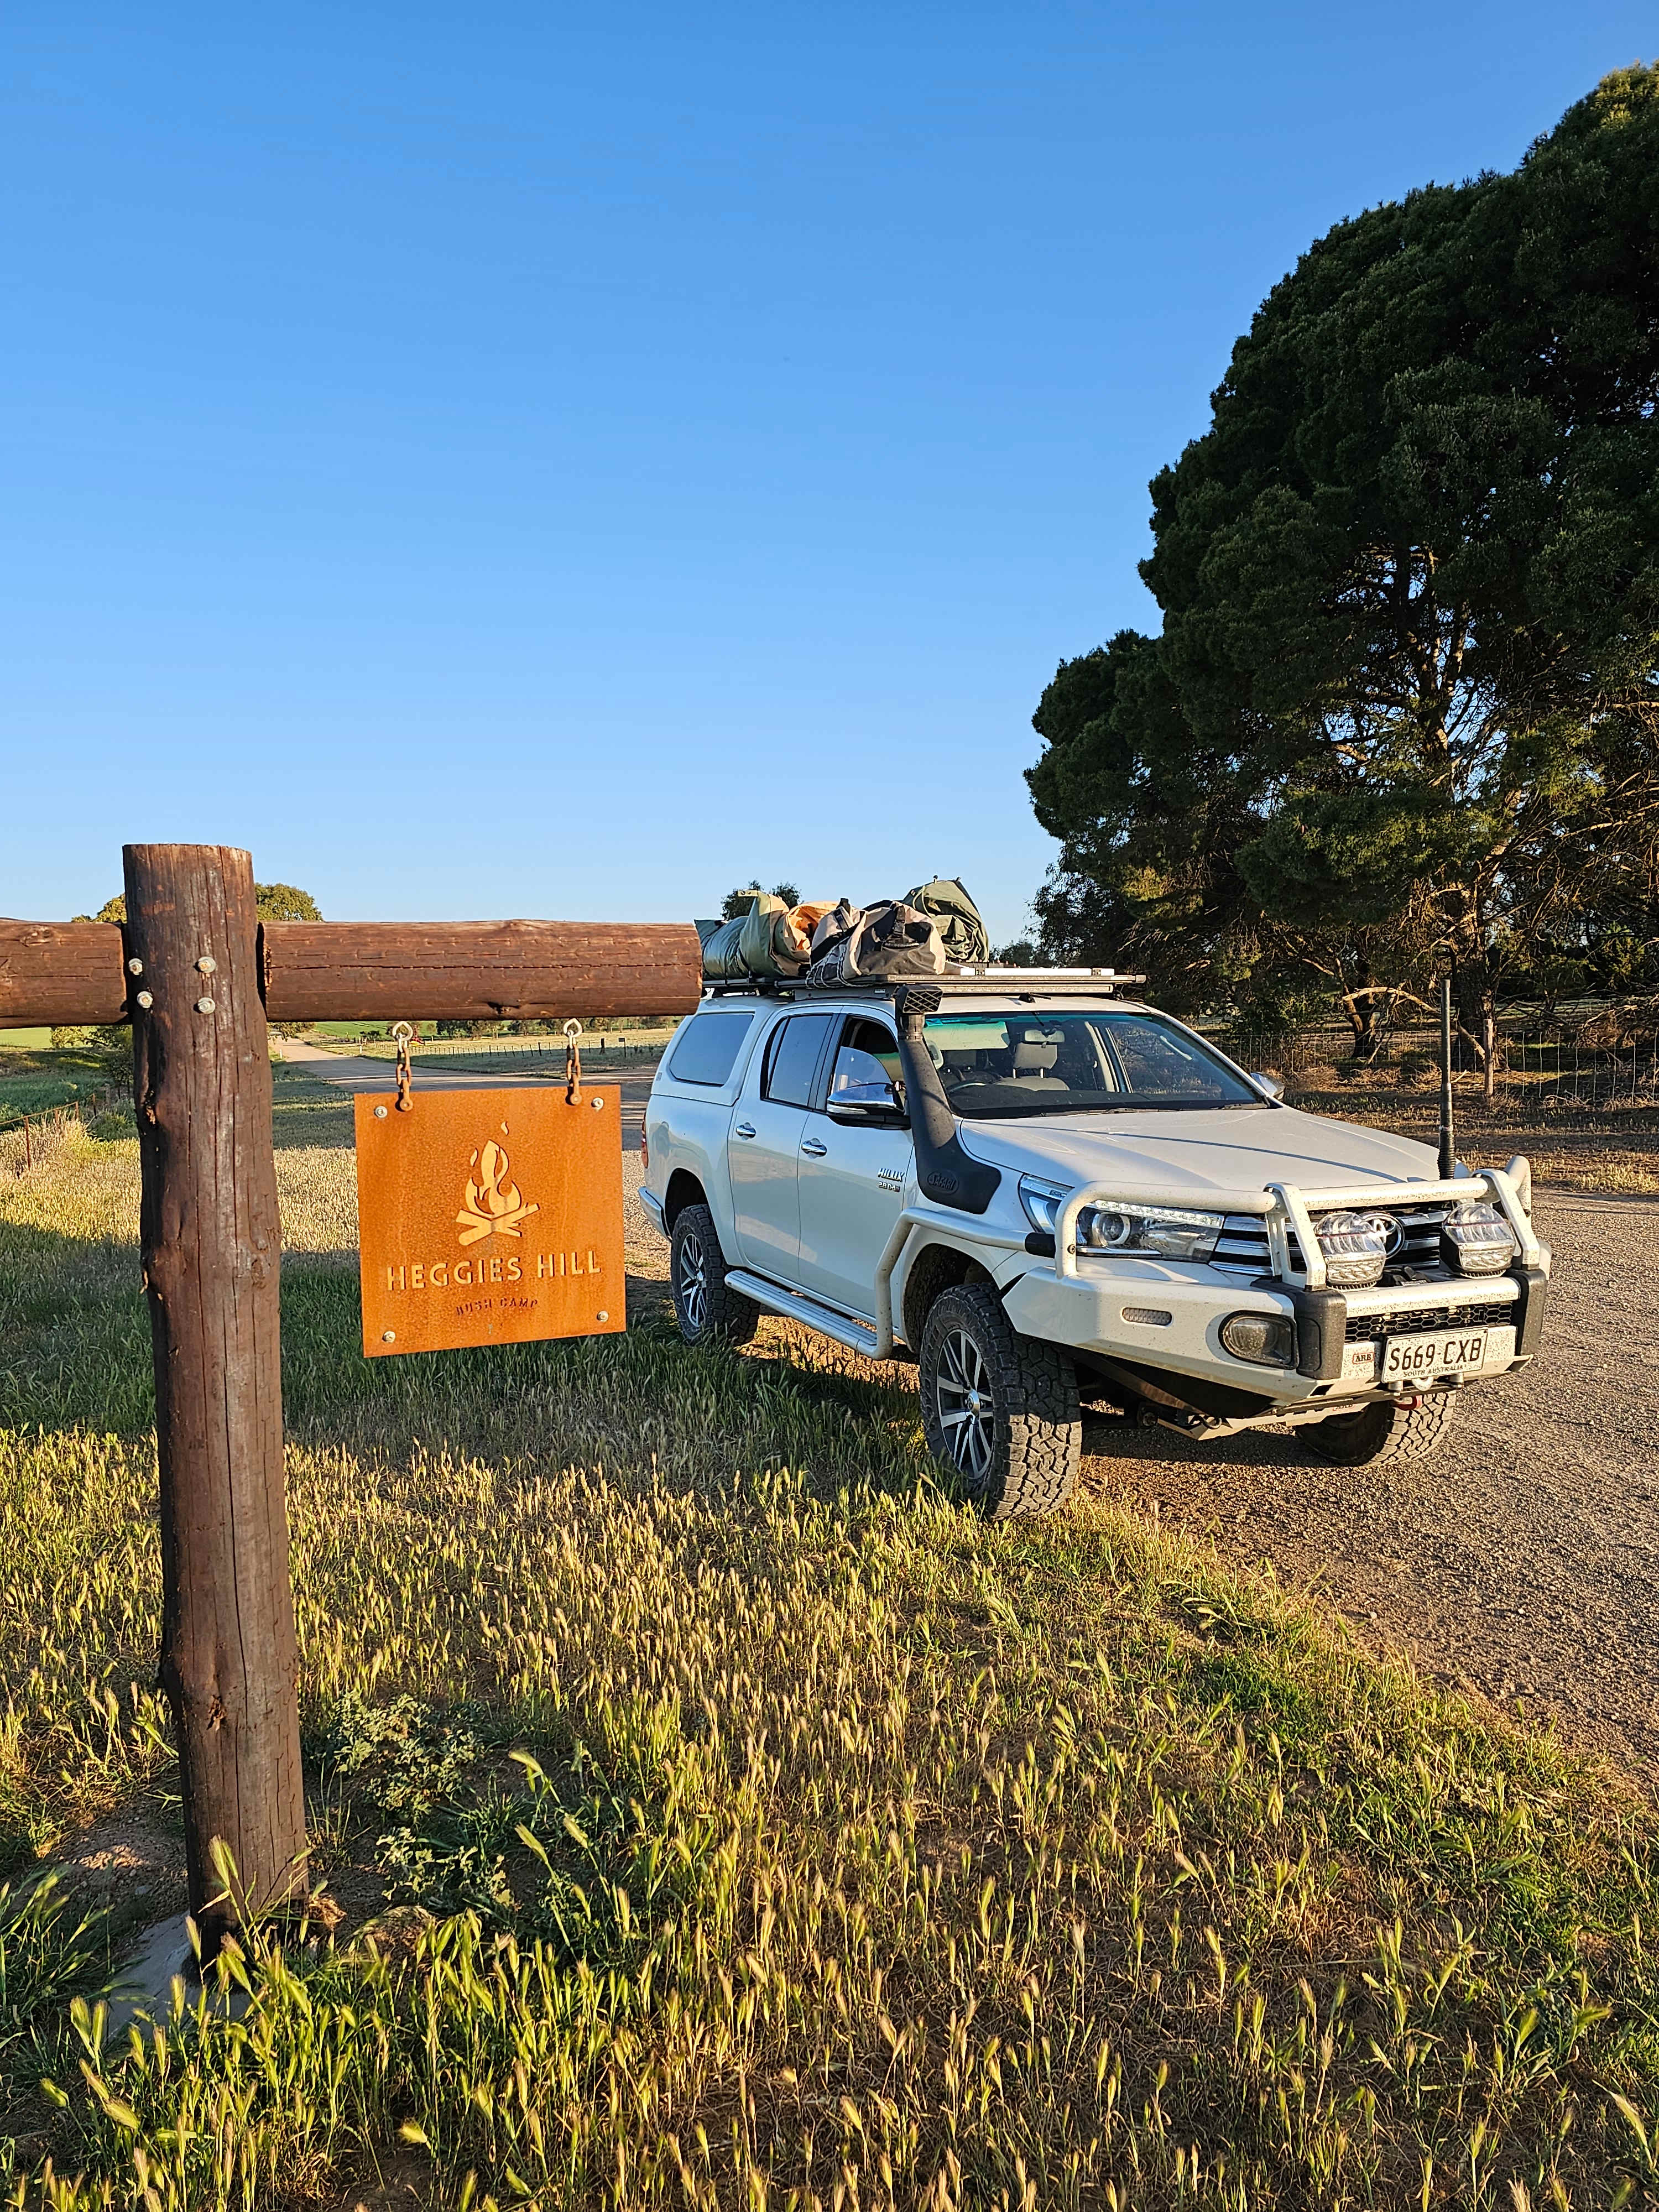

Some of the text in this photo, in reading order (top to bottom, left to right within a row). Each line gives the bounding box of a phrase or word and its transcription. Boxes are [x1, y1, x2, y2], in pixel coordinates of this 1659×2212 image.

[878, 1167, 905, 1182] HILUX
[387, 1250, 601, 1291] HEGGIES HILL
[456, 1297, 538, 1315] BUSH CAMP
[1355, 1354, 1371, 1362] ARB
[1389, 1338, 1482, 1371] S669 CXB
[1427, 1365, 1463, 1375] AUSTRALIA
